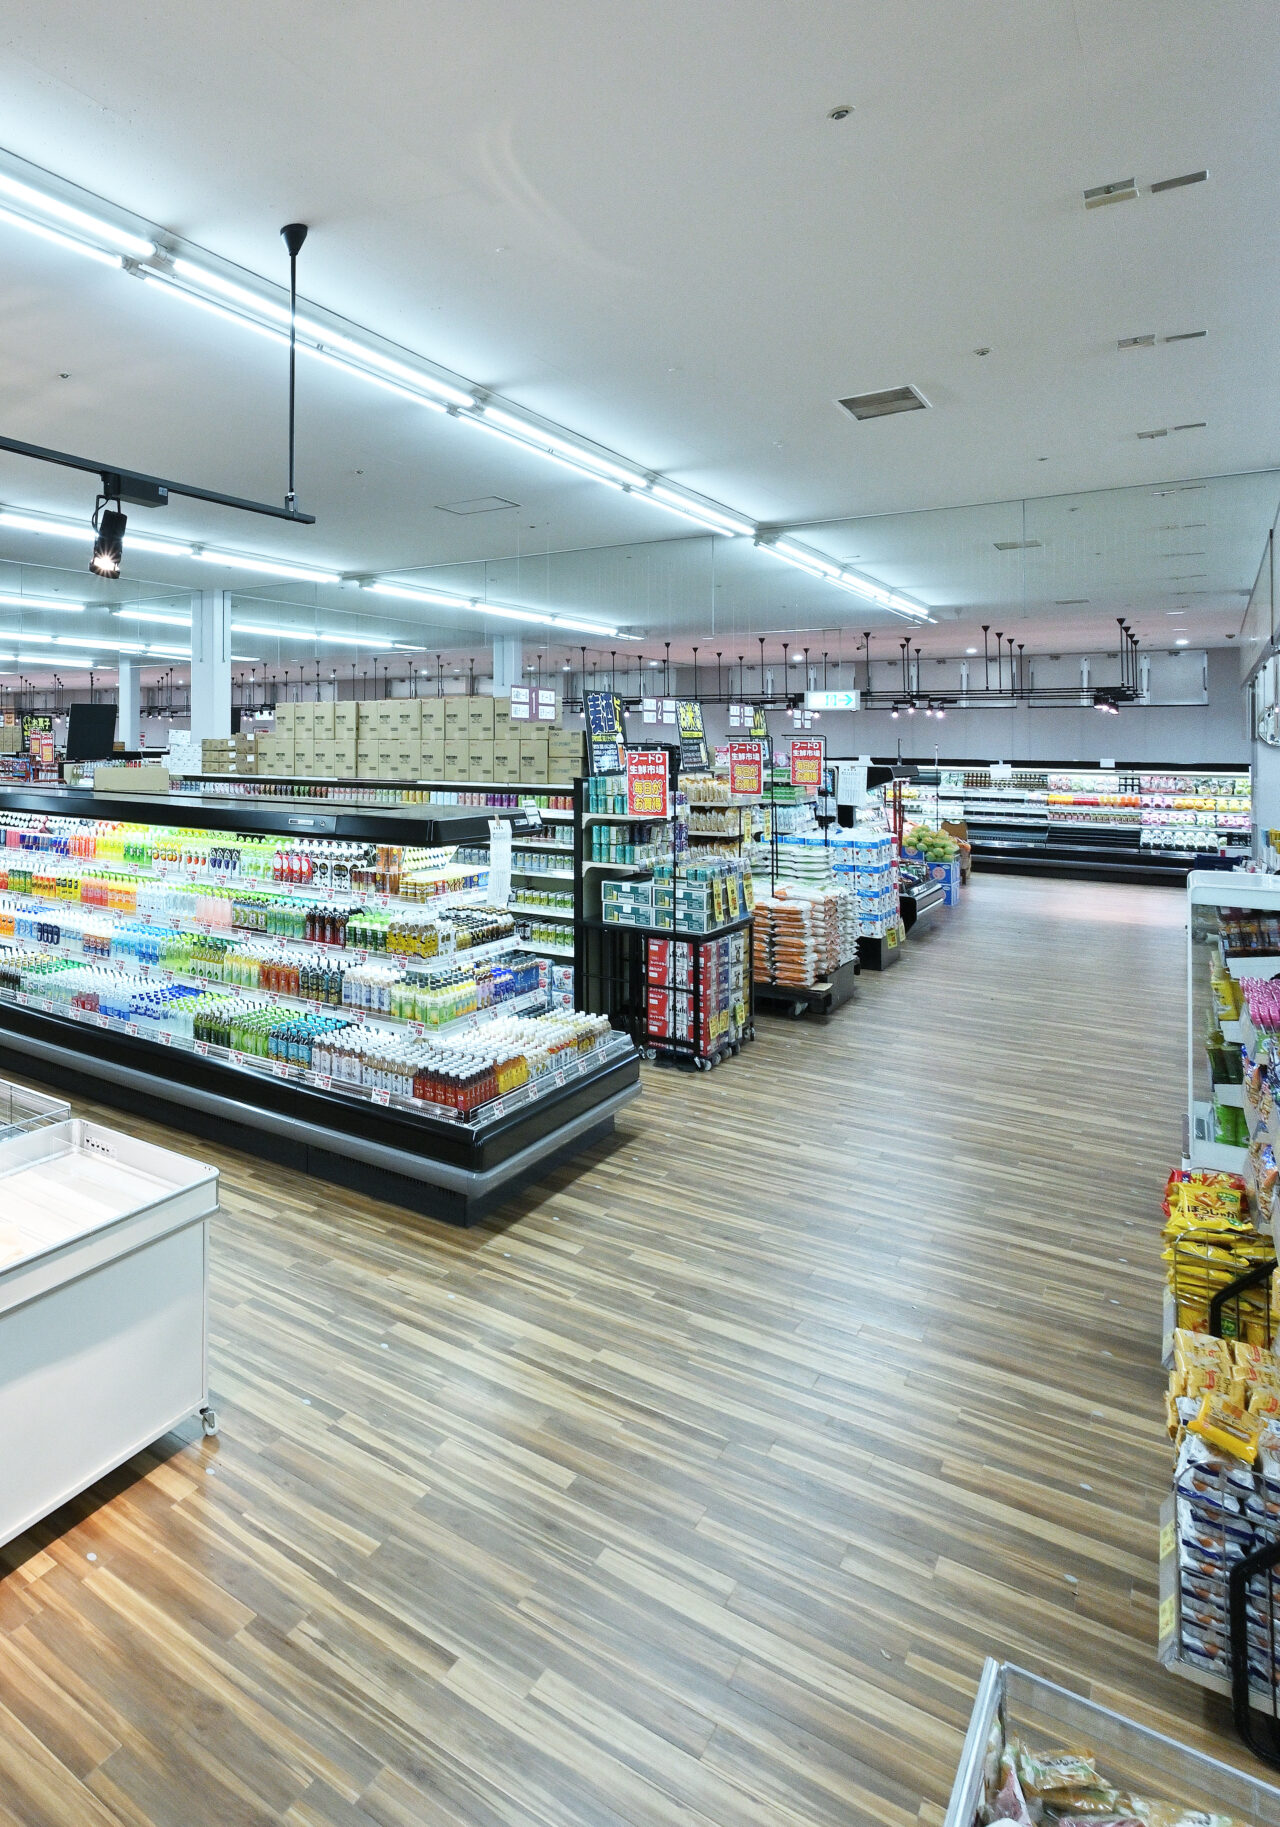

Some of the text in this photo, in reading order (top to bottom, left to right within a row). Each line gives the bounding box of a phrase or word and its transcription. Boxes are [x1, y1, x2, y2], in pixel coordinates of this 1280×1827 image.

[731, 744, 759, 752] フードD
[630, 754, 663, 763] フードD
[629, 765, 665, 775] 生鮮市場
[633, 780, 663, 795] 毎日が
[634, 796, 663, 811] お買得
